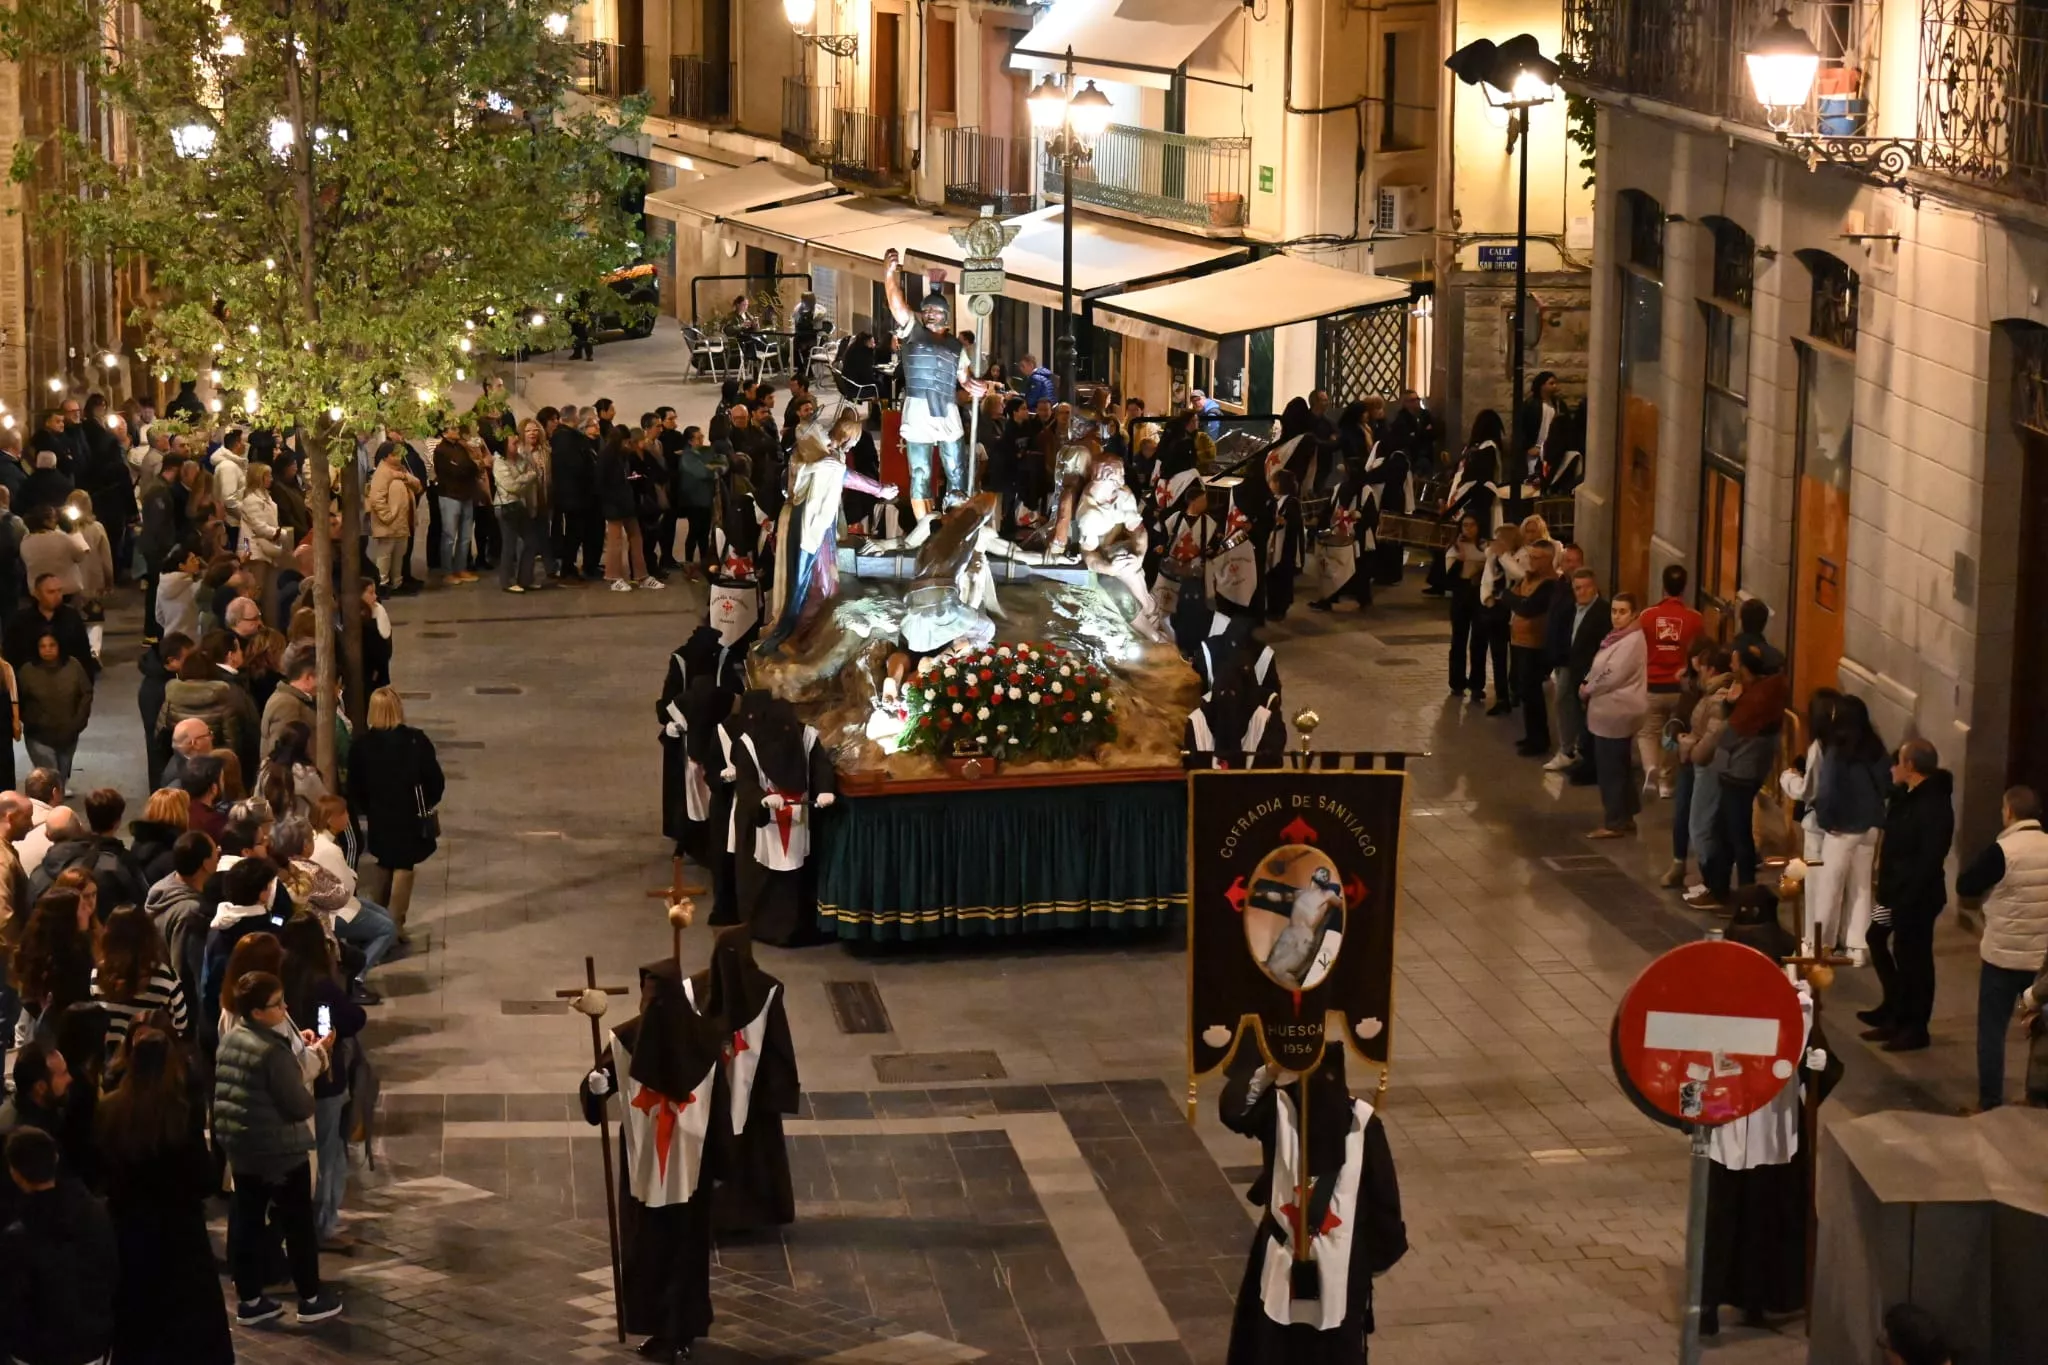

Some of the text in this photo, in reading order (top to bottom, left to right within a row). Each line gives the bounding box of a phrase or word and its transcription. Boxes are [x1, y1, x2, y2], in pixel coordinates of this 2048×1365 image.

[1489, 248, 1512, 256] CALLE
[1494, 261, 1518, 270] ORENCI
[1220, 794, 1376, 859] COFRADIA DE SANTIAGO
[1268, 1023, 1323, 1037] HUESCA
[1283, 1043, 1313, 1054] 1956
